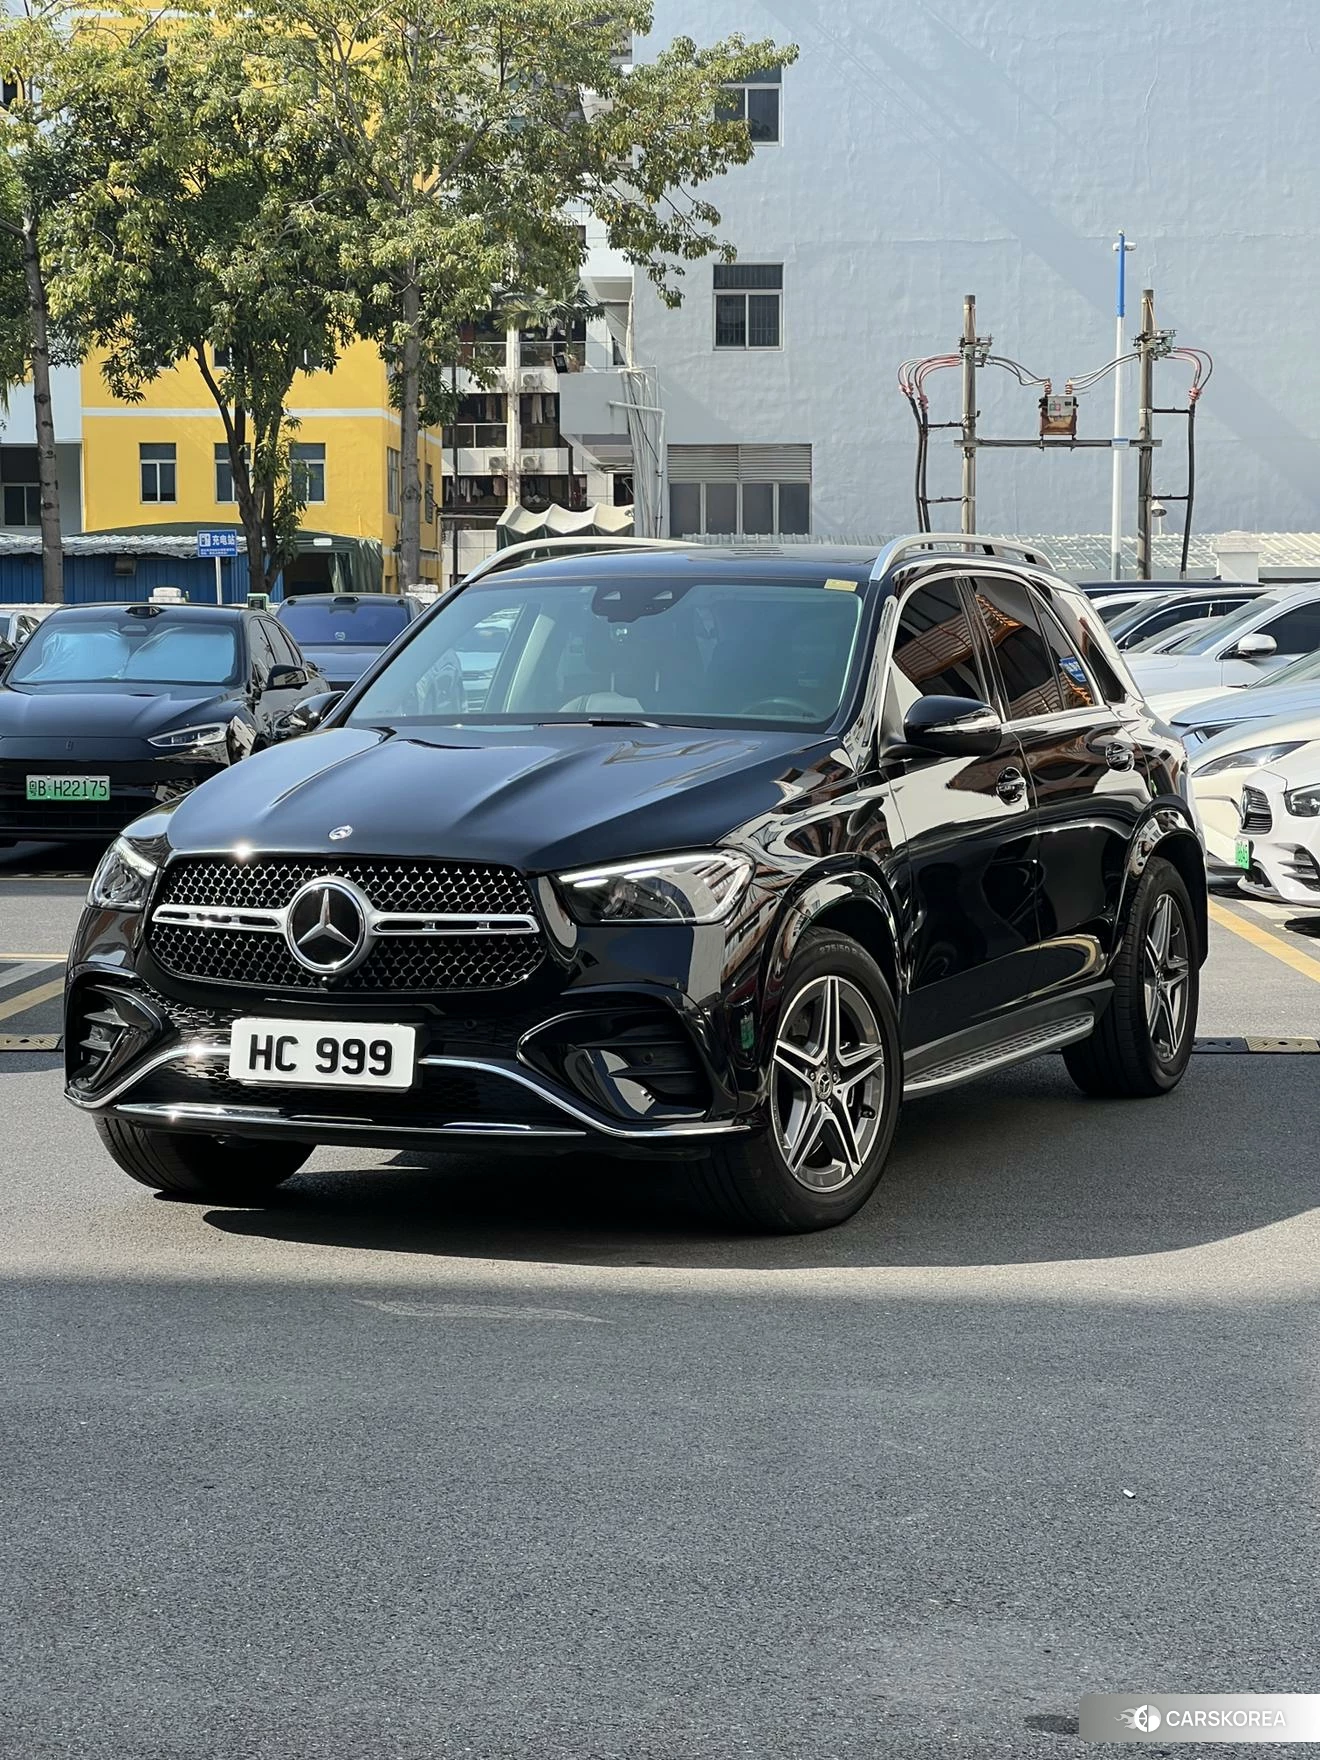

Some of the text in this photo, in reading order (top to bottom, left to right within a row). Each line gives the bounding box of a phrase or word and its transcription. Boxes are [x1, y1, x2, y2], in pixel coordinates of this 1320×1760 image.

[212, 534, 235, 546] 充电站
[249, 1034, 393, 1076] HC 999
